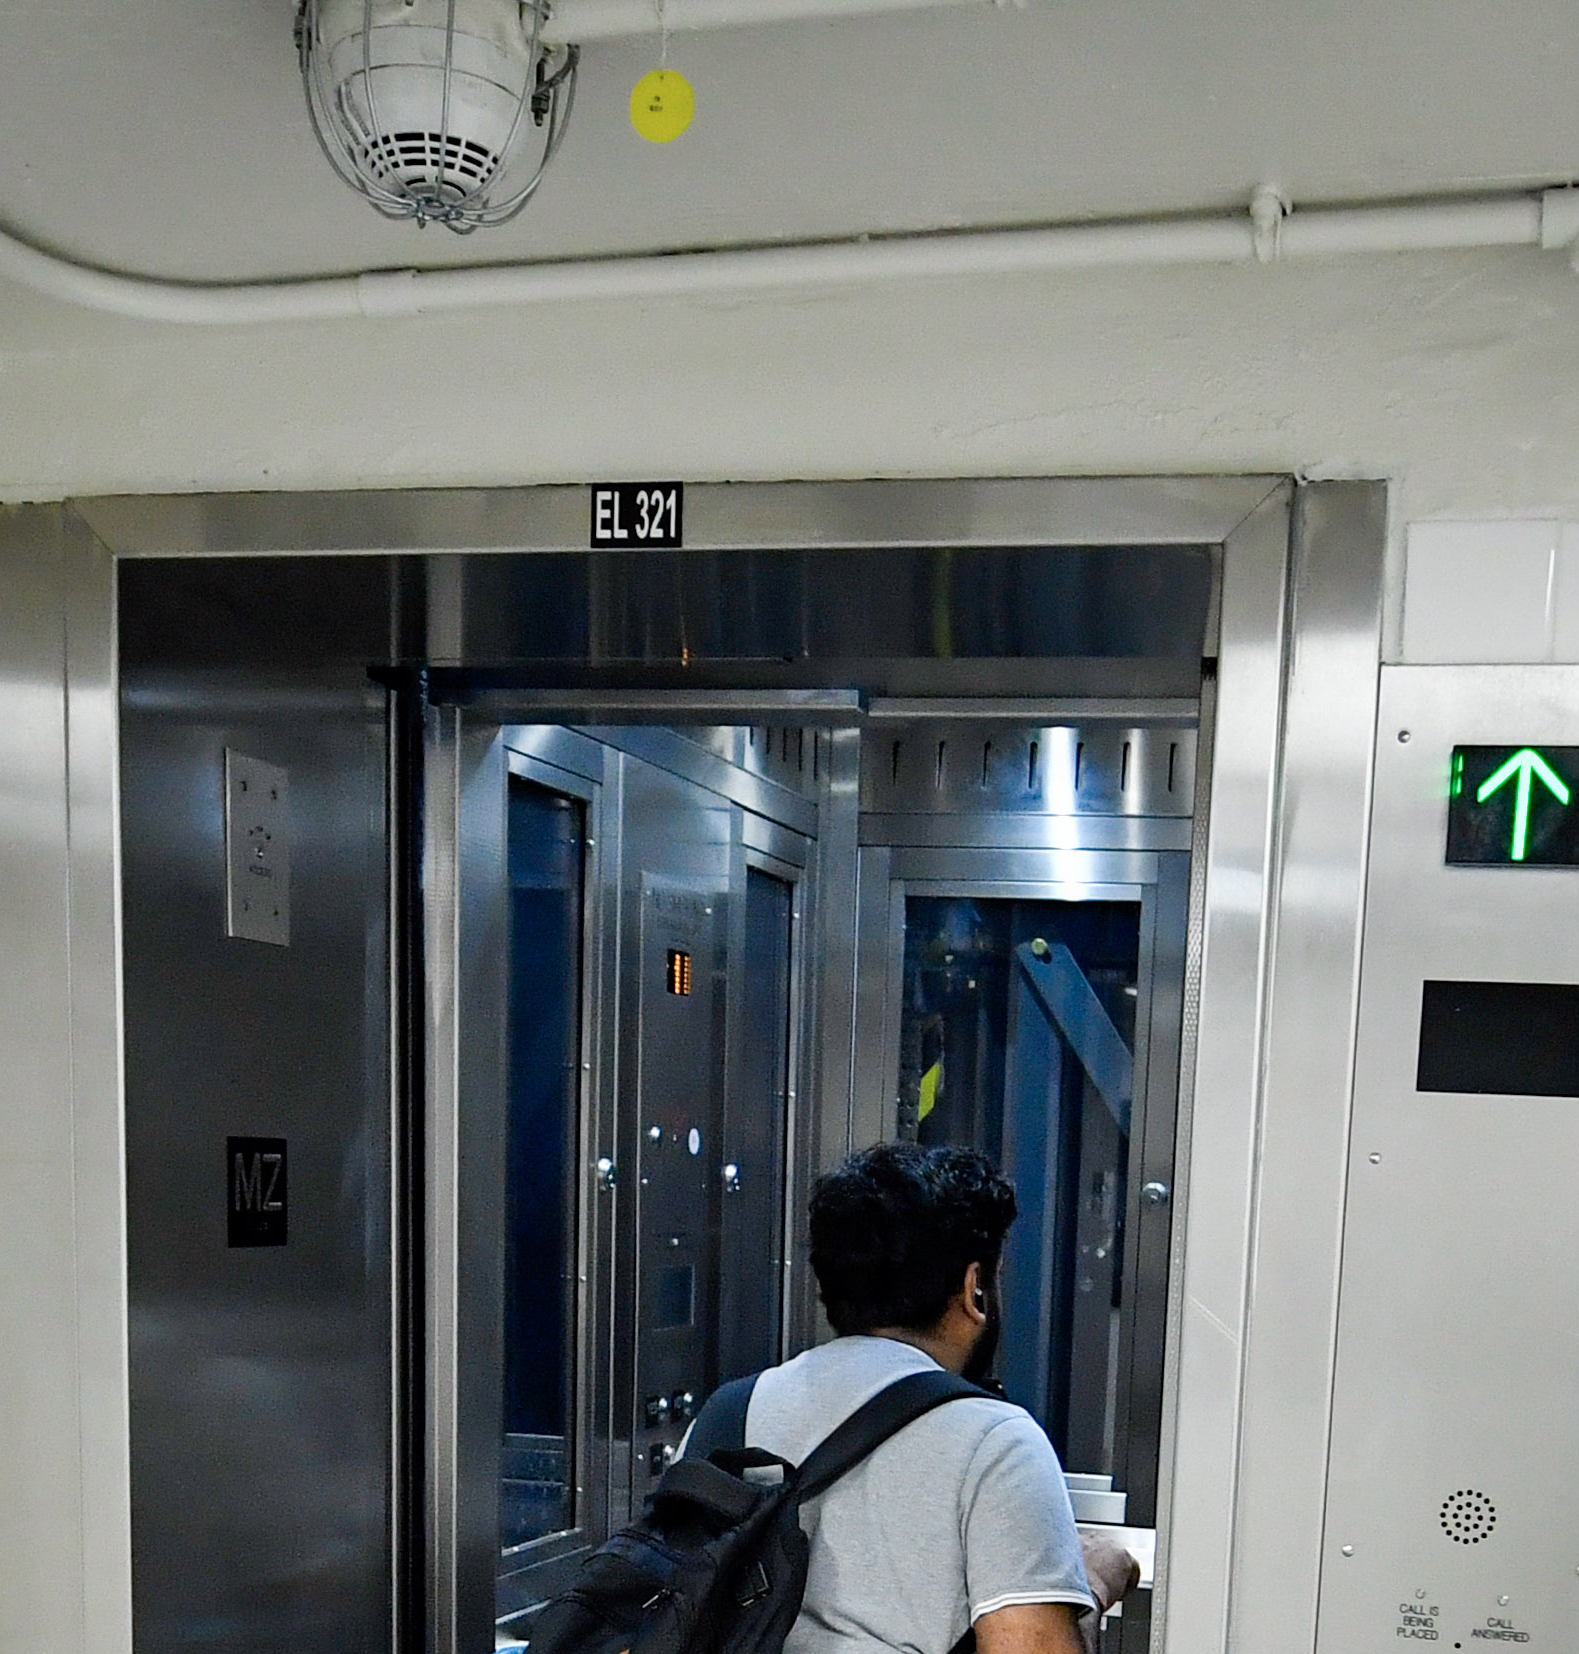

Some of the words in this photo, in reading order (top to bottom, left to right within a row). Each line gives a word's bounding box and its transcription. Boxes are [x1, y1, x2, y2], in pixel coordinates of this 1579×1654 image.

[595, 490, 628, 539] EL
[635, 489, 676, 539] 321
[1399, 1603, 1426, 1615] CALL
[1429, 1606, 1440, 1617] IS
[1403, 1616, 1434, 1628] BEING
[1487, 1617, 1515, 1629] CALL
[1397, 1627, 1439, 1640] PLACED
[1471, 1629, 1530, 1643] ANSWERED
